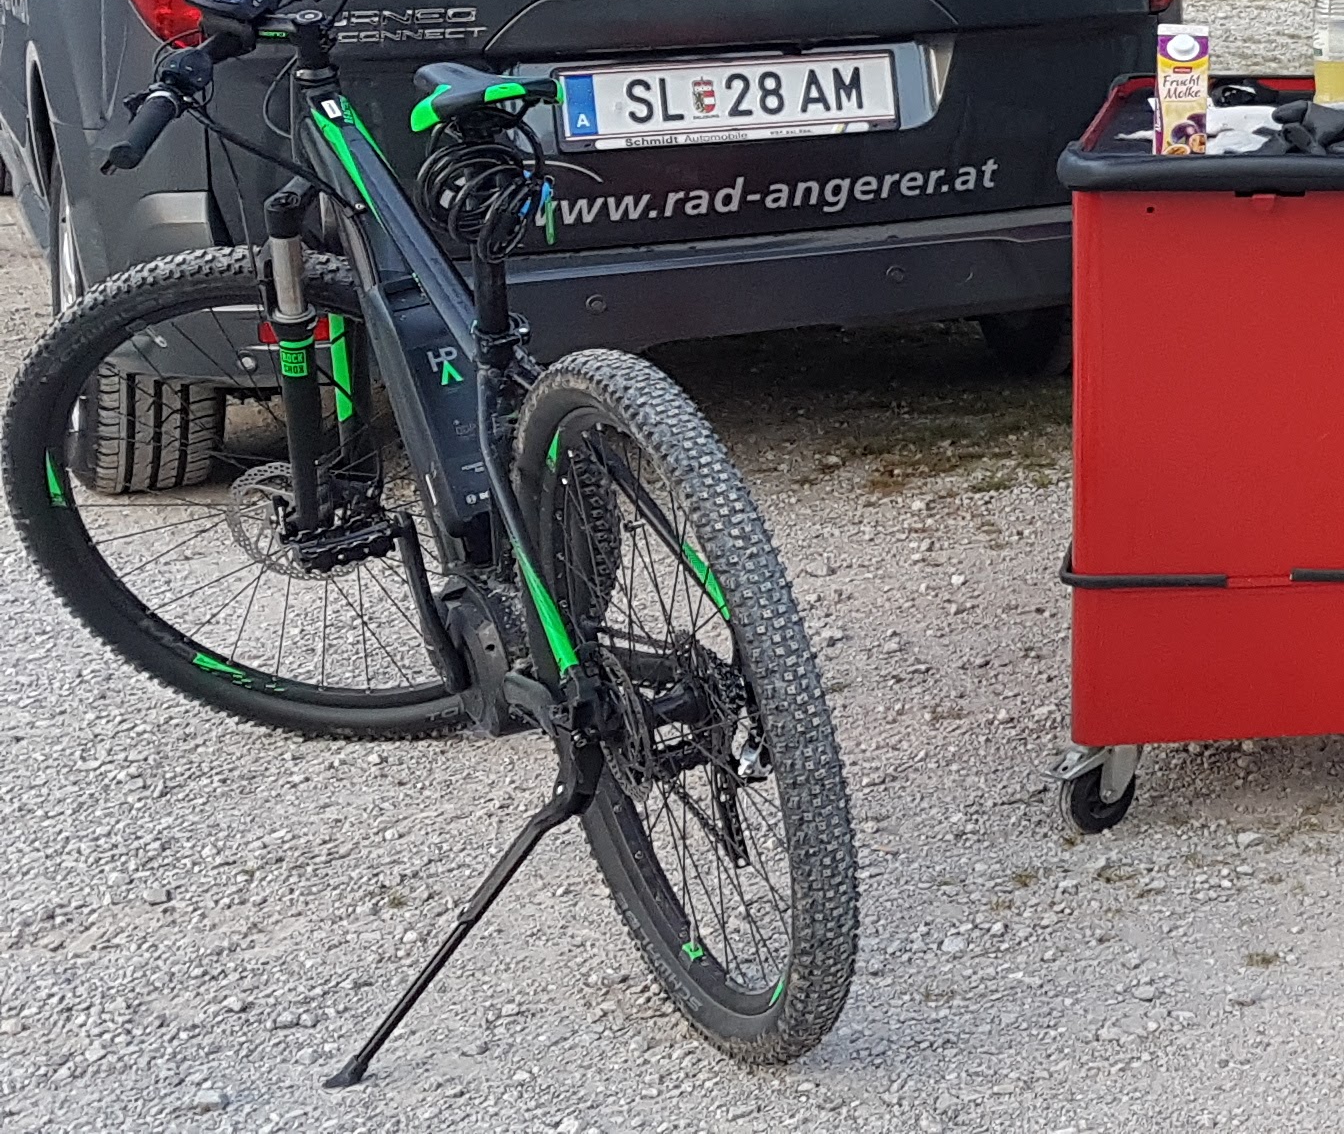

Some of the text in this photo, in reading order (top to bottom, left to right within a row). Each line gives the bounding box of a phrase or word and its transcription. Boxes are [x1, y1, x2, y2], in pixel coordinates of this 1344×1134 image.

[337, 27, 487, 43] CONNECT
[1162, 74, 1201, 88] Frucht
[625, 66, 864, 124] SL 28 AM
[1164, 86, 1201, 101] Molke
[576, 113, 591, 128] A
[624, 131, 749, 148] Schmidt Automobile
[616, 891, 704, 1012] SCHWALBE
